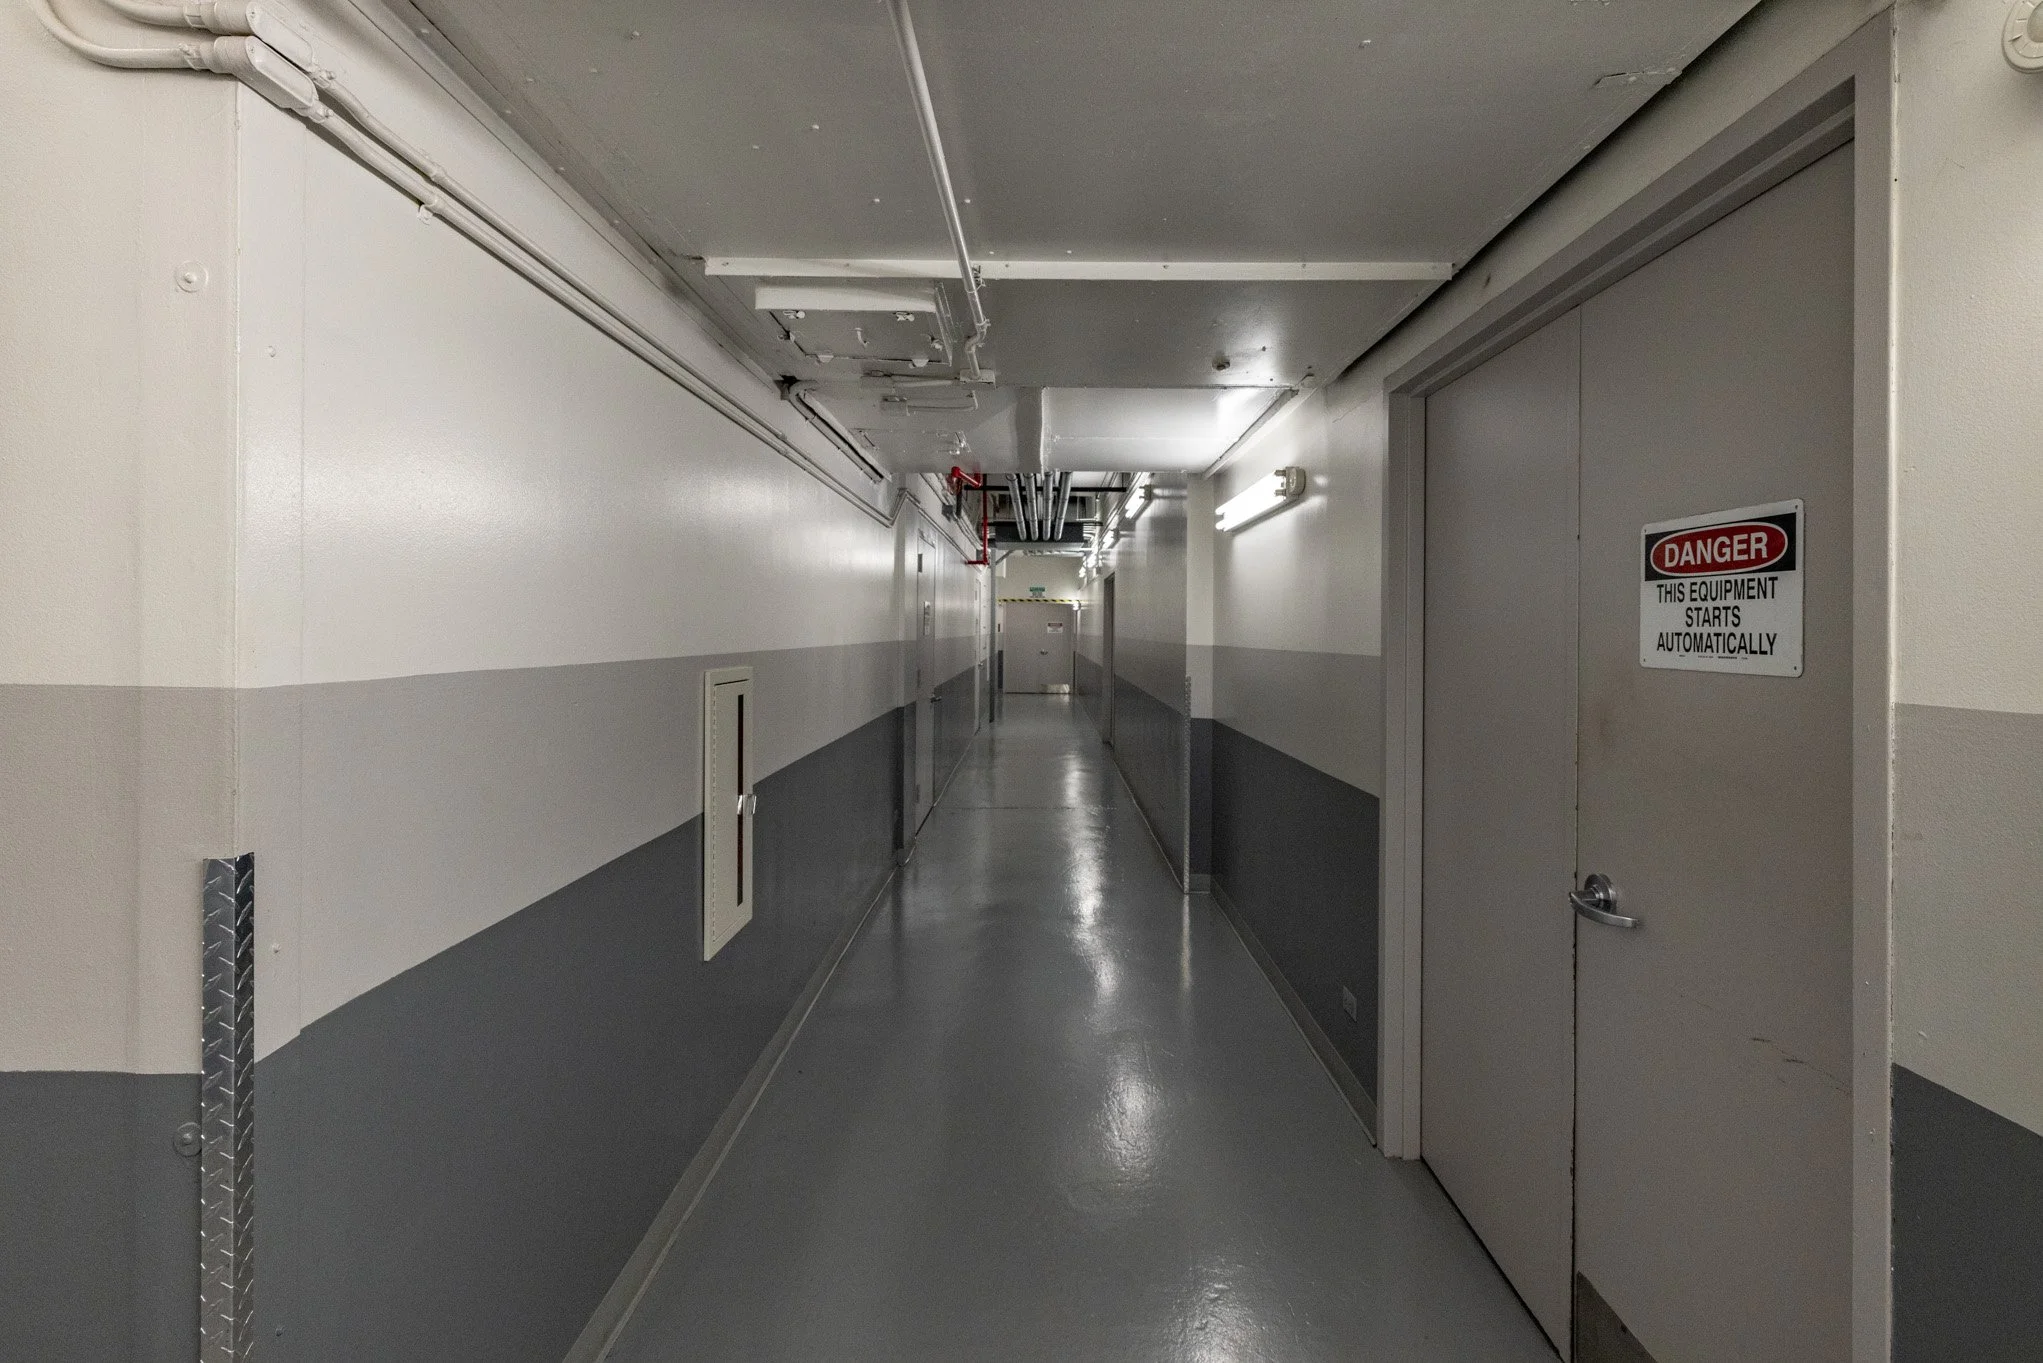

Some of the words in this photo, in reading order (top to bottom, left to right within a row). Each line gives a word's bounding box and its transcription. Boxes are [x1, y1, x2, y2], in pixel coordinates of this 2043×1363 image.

[1664, 531, 1768, 568] DANGER
[1656, 582, 1685, 603] THIS
[1690, 576, 1778, 602] EQUIPMENT
[1685, 605, 1741, 627] STARTS
[1656, 632, 1777, 655] AUTOMATICALLY
